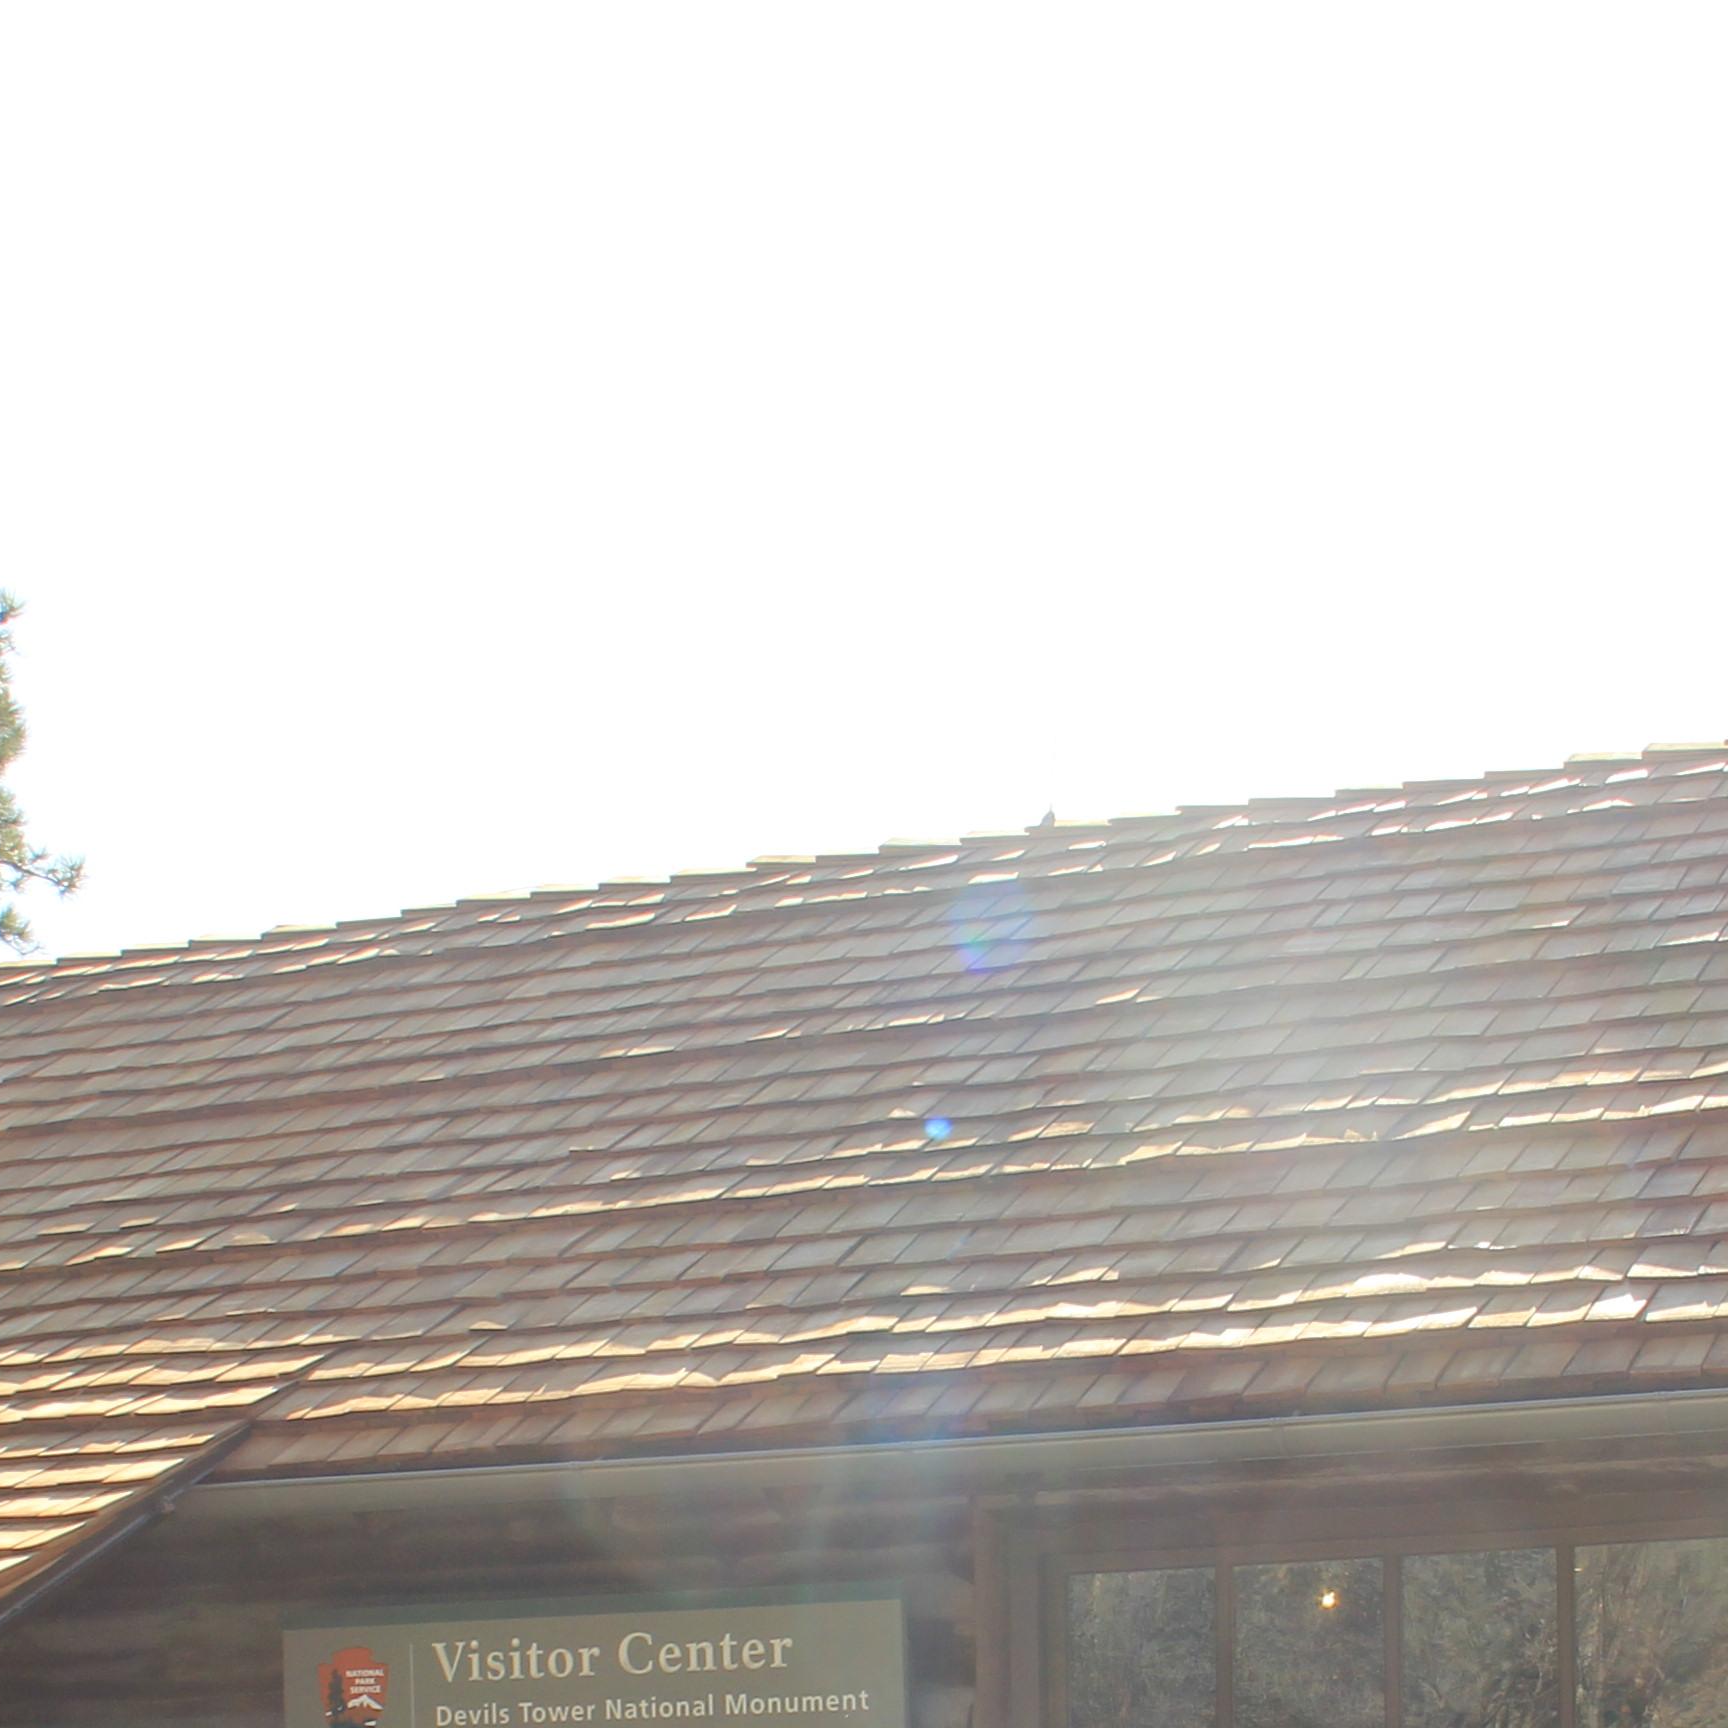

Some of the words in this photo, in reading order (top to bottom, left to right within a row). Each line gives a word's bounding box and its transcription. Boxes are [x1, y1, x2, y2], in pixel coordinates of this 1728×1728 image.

[431, 1637, 601, 1683] Visitor
[618, 1632, 793, 1675] Center
[345, 1668, 385, 1678] NATIONAL
[355, 1677, 376, 1686] PARK
[350, 1684, 382, 1695] SERVICE
[436, 1702, 510, 1727] Devils
[518, 1701, 596, 1723] Tower
[605, 1693, 714, 1720] National
[724, 1690, 870, 1715] Monument
